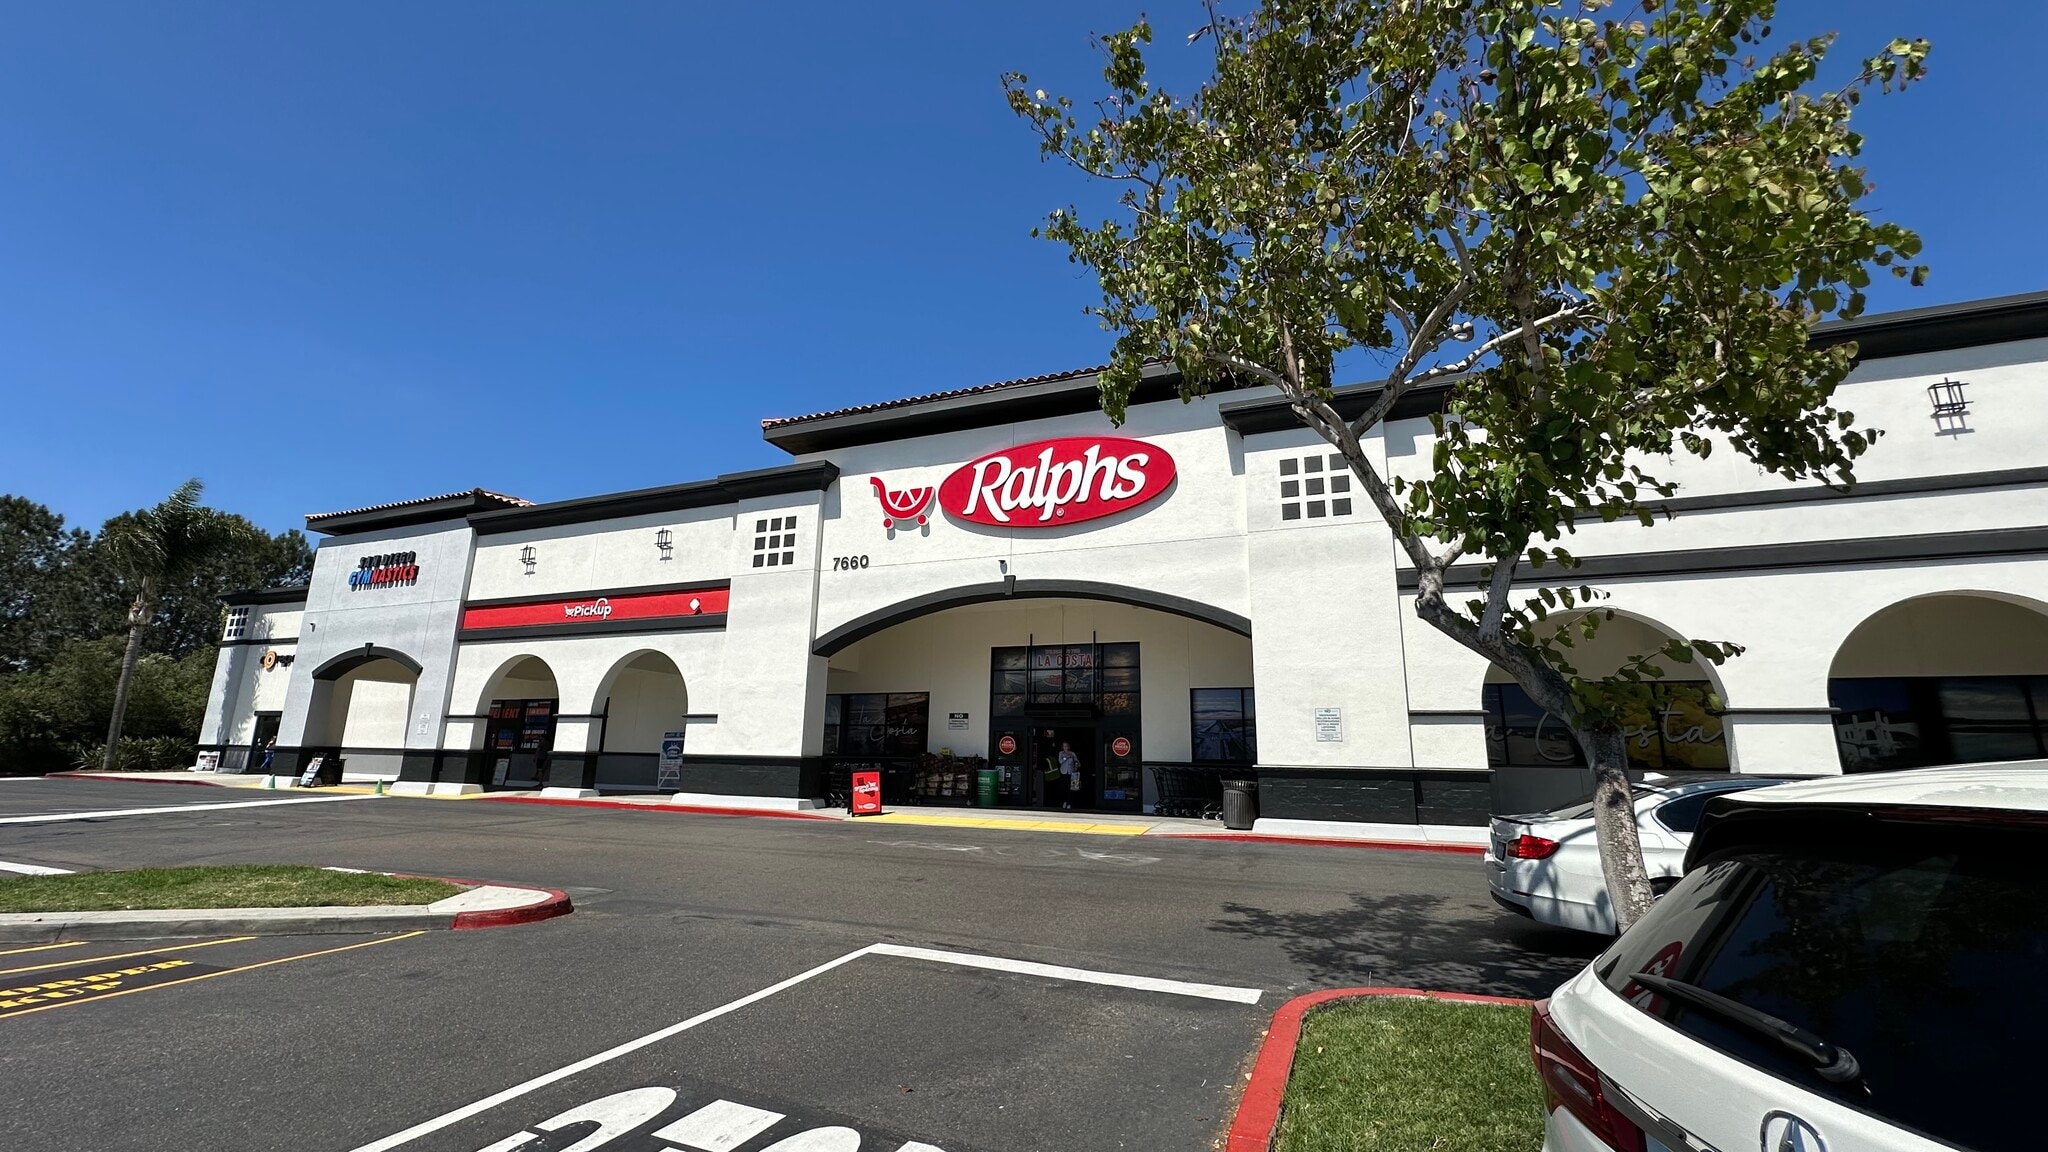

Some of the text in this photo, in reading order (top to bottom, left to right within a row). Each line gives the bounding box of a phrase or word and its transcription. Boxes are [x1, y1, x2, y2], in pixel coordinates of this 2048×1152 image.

[963, 444, 1150, 523] Ralphs
[358, 551, 416, 569] SAN DIEGO
[833, 554, 869, 571] 7660
[348, 565, 418, 586] GYMNASTICS
[1037, 653, 1093, 667] LA COSTA
[1535, 697, 1725, 763] Csta
